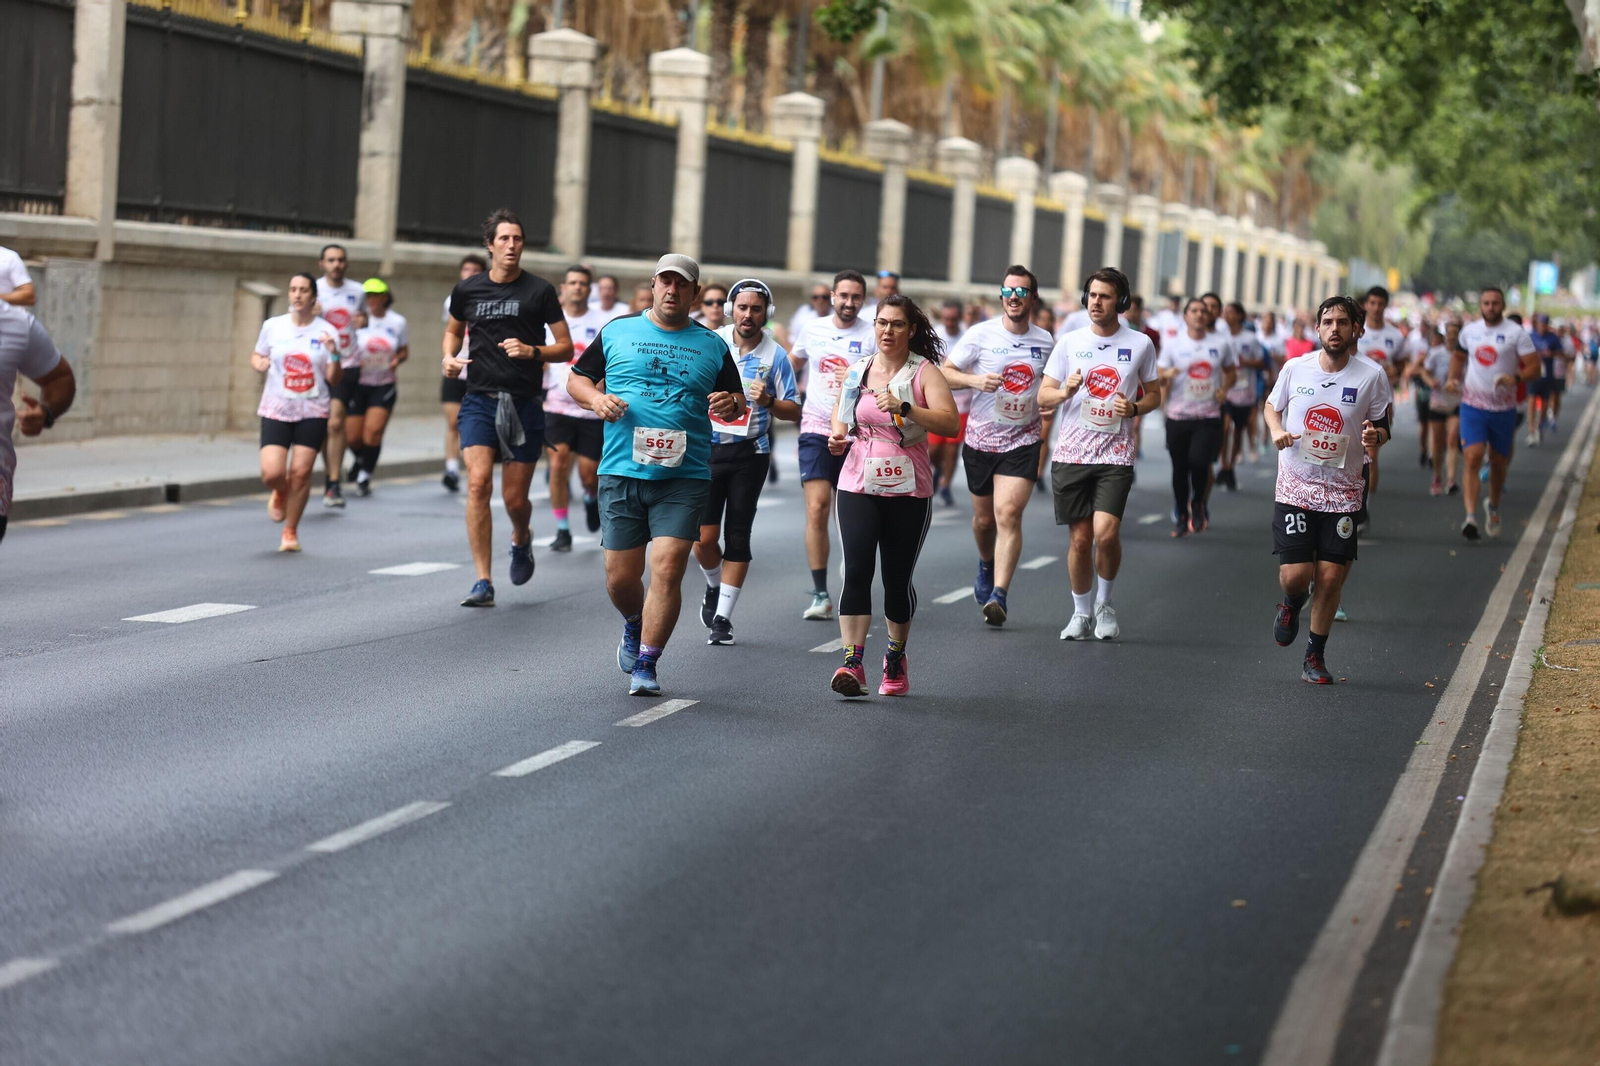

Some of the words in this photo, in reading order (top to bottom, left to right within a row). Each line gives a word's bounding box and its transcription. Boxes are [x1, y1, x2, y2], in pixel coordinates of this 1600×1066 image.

[680, 346, 702, 356] FONDO
[1007, 368, 1031, 382] PONLE
[1092, 372, 1117, 385] PONLE
[1089, 379, 1114, 391] FRENO
[1004, 402, 1026, 412] 217
[1091, 407, 1113, 418] 584
[1311, 411, 1339, 428] PONLE
[1308, 419, 1336, 434] FRENO
[646, 437, 674, 449] 567
[1312, 439, 1338, 451] 903
[876, 466, 902, 477] 196
[1285, 513, 1307, 534] 26
